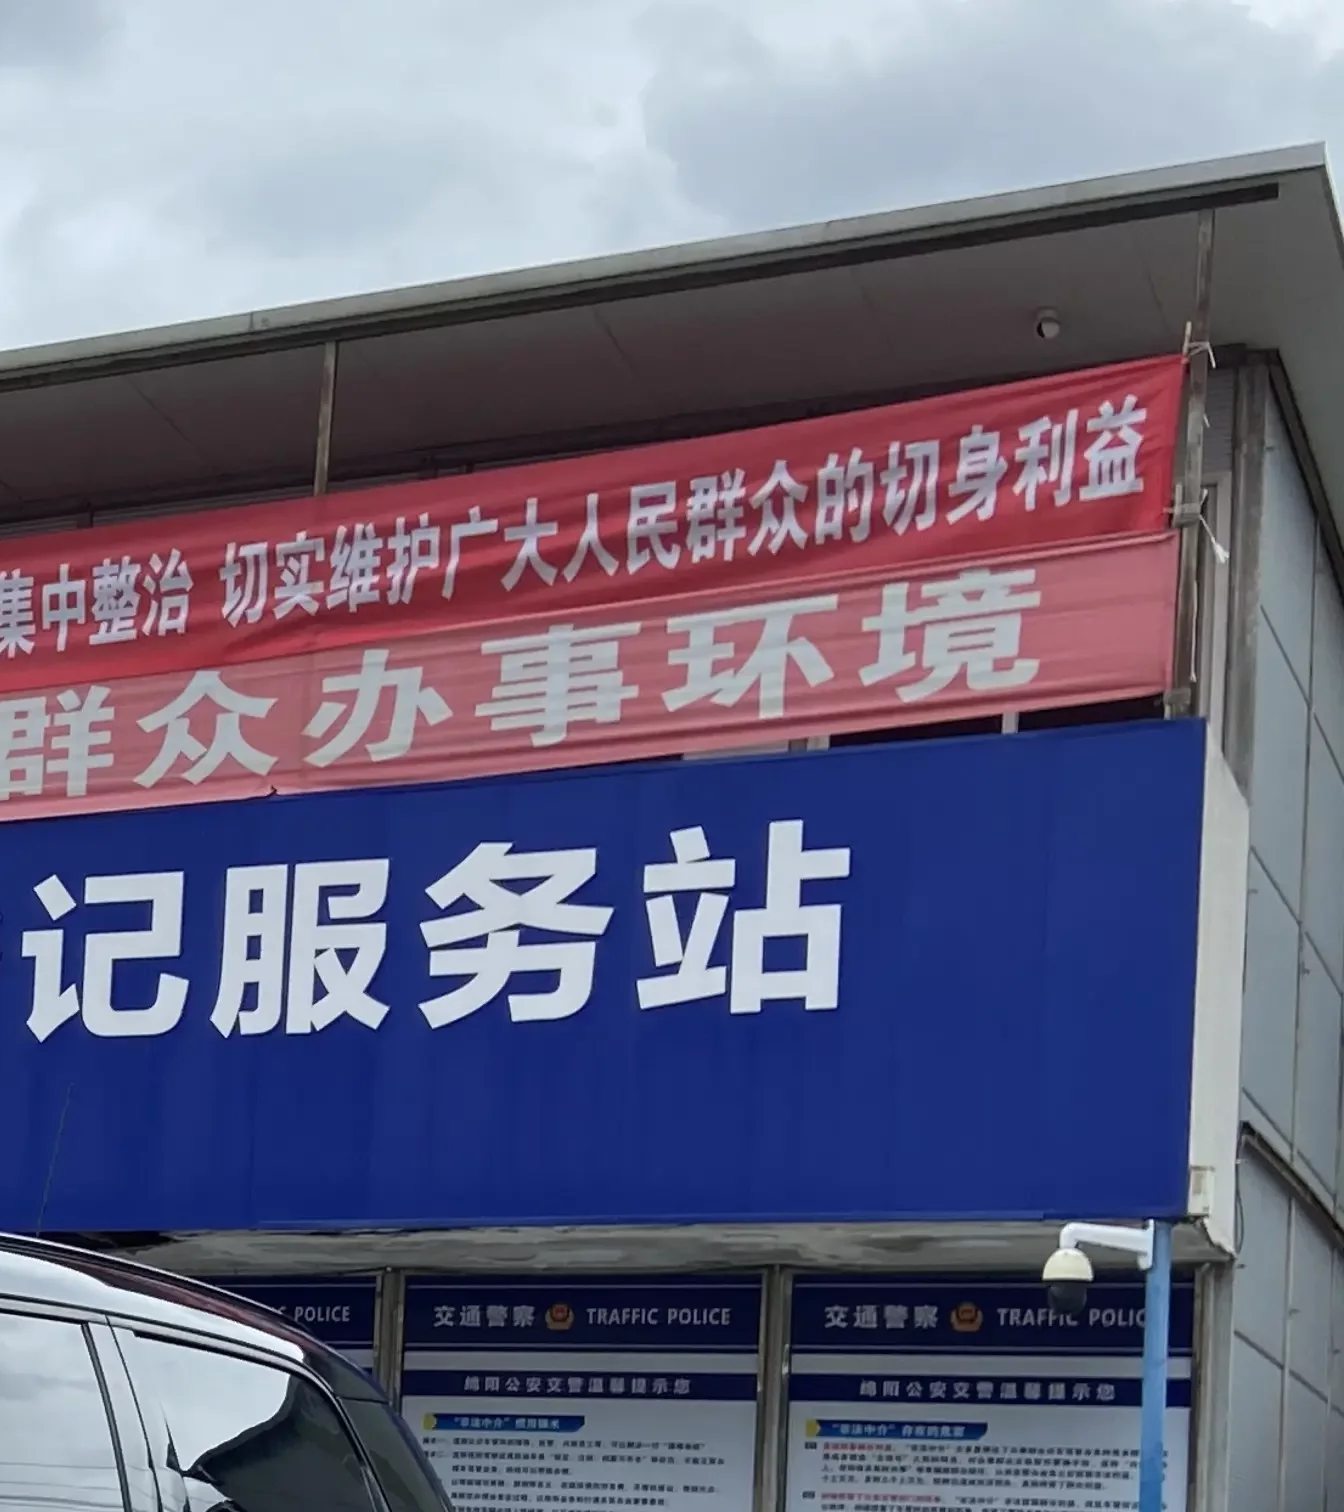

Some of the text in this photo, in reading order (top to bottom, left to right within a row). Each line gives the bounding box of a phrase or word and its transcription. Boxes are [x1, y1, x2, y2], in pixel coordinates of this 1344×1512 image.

[218, 394, 1150, 628] 切实维护广大人民群众的切身利益
[294, 1305, 351, 1323] POLICE
[433, 1304, 536, 1329] 交通警察
[586, 1307, 732, 1326] TRAFFIC POLICE
[824, 1304, 939, 1330] 交通警察
[1088, 1308, 1147, 1328] POLIC
